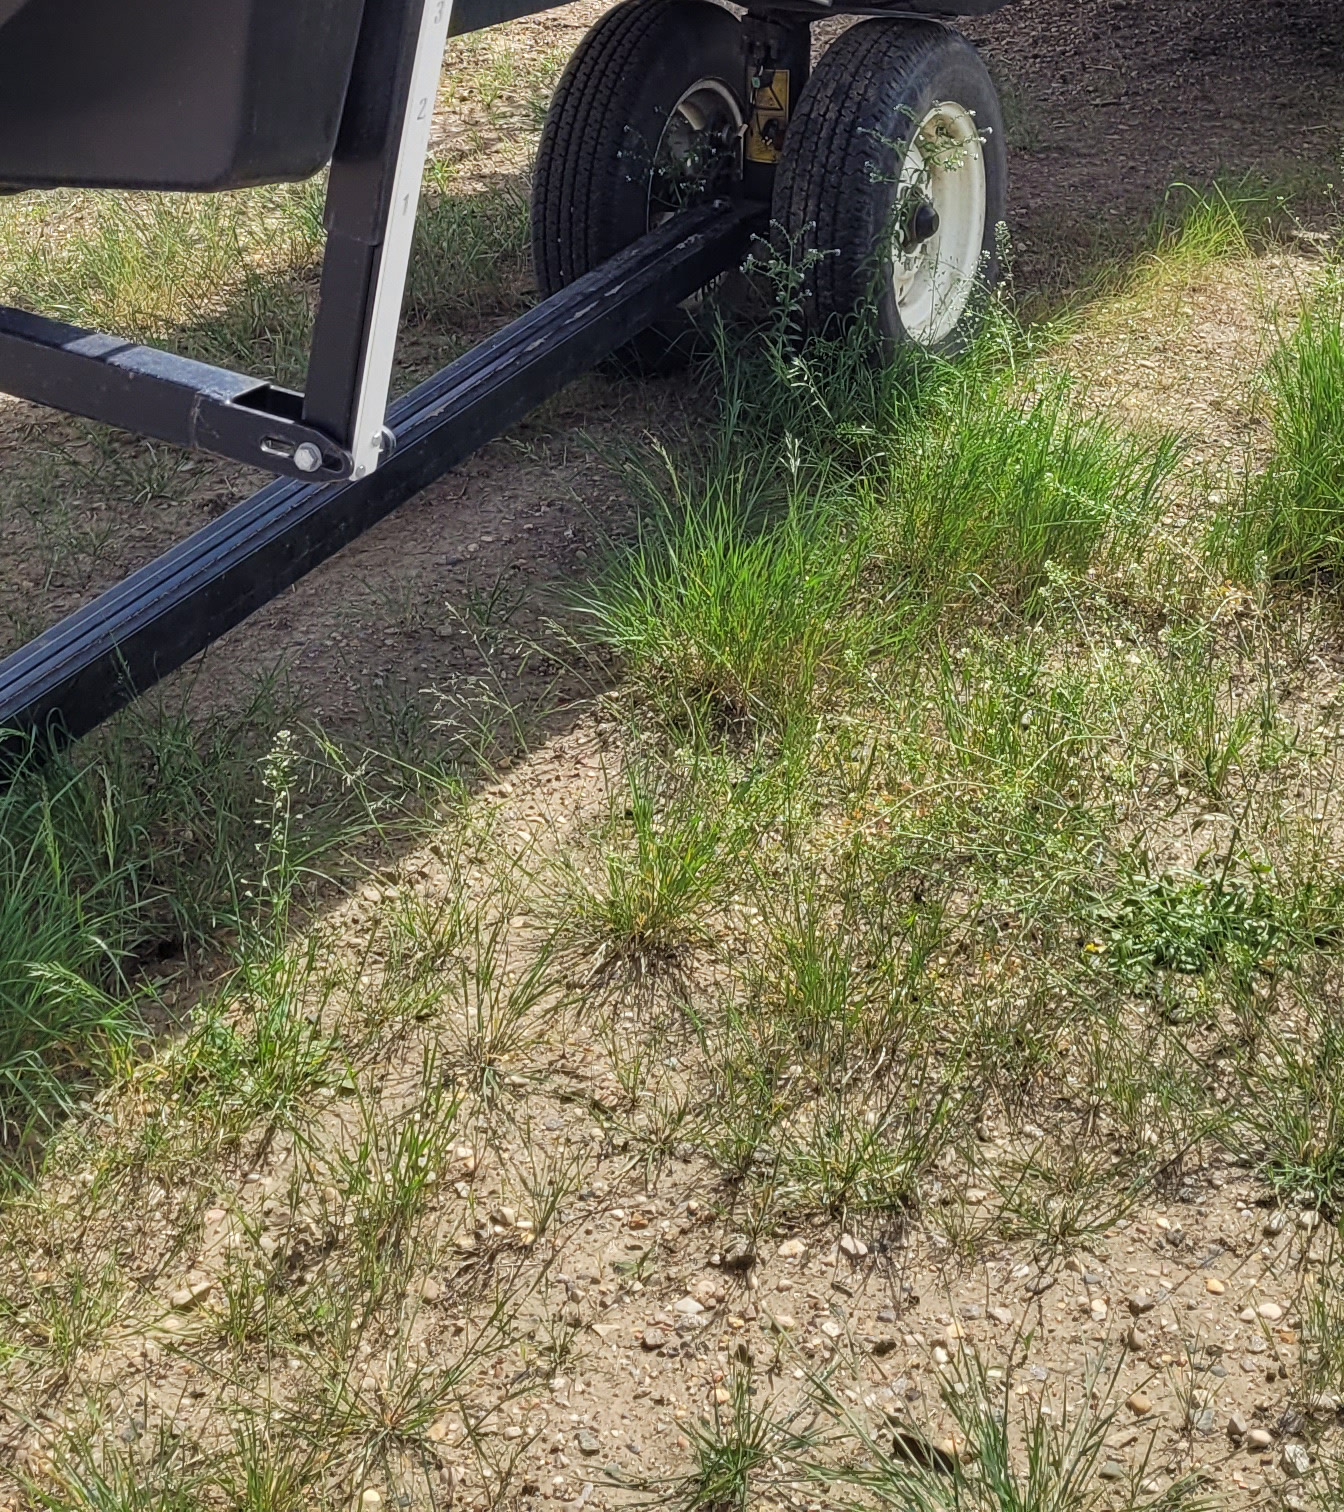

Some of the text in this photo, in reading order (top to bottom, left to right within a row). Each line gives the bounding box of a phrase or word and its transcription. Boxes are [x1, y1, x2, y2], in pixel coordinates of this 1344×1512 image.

[434, 0, 445, 24] 3
[416, 97, 427, 120] 2
[402, 192, 410, 216] 1
